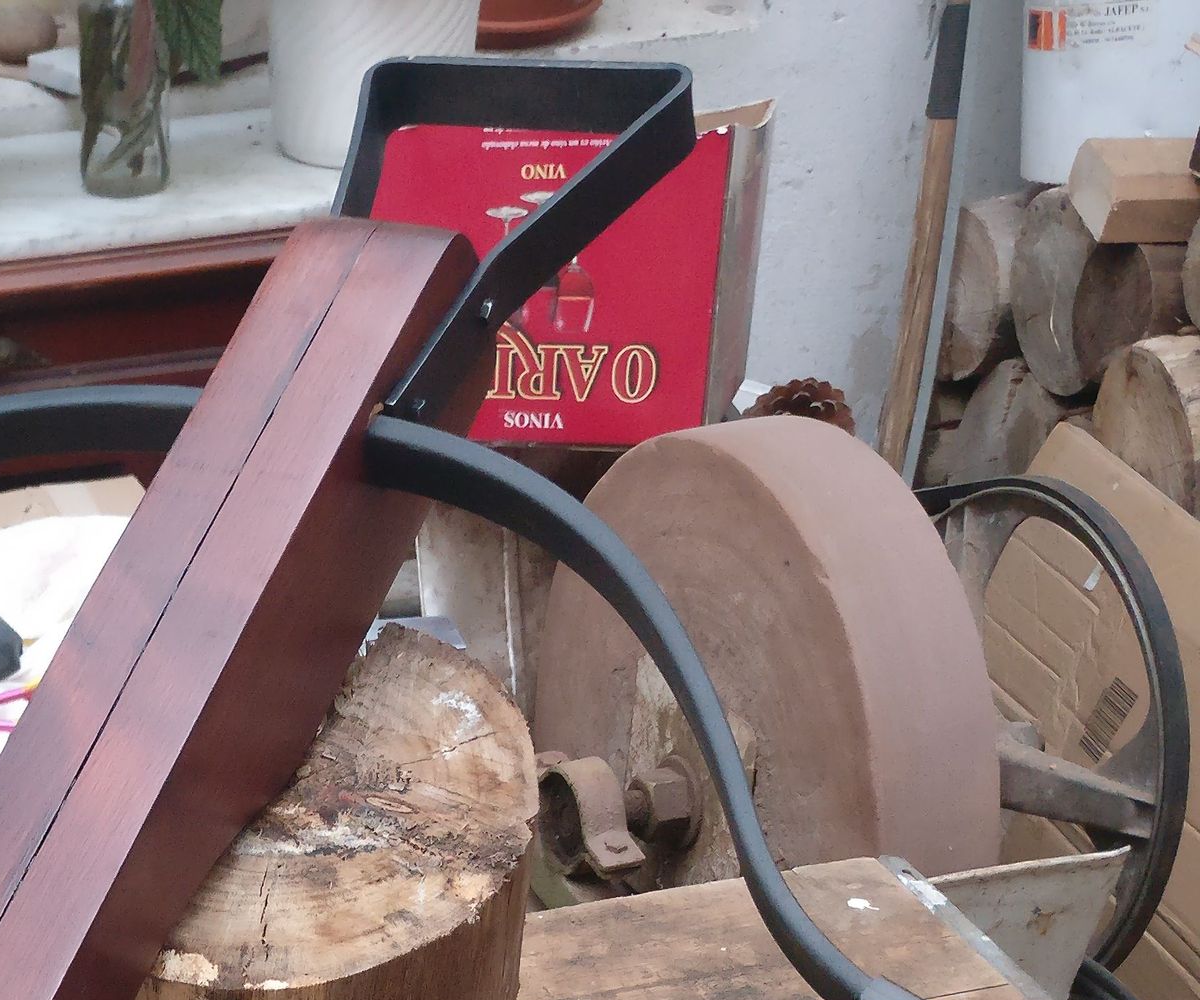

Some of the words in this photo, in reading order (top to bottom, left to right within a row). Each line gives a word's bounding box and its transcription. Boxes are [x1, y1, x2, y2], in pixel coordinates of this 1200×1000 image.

[520, 163, 567, 180] VINO
[485, 321, 608, 402] ARI
[611, 344, 657, 404] O
[503, 409, 564, 430] VINOS
